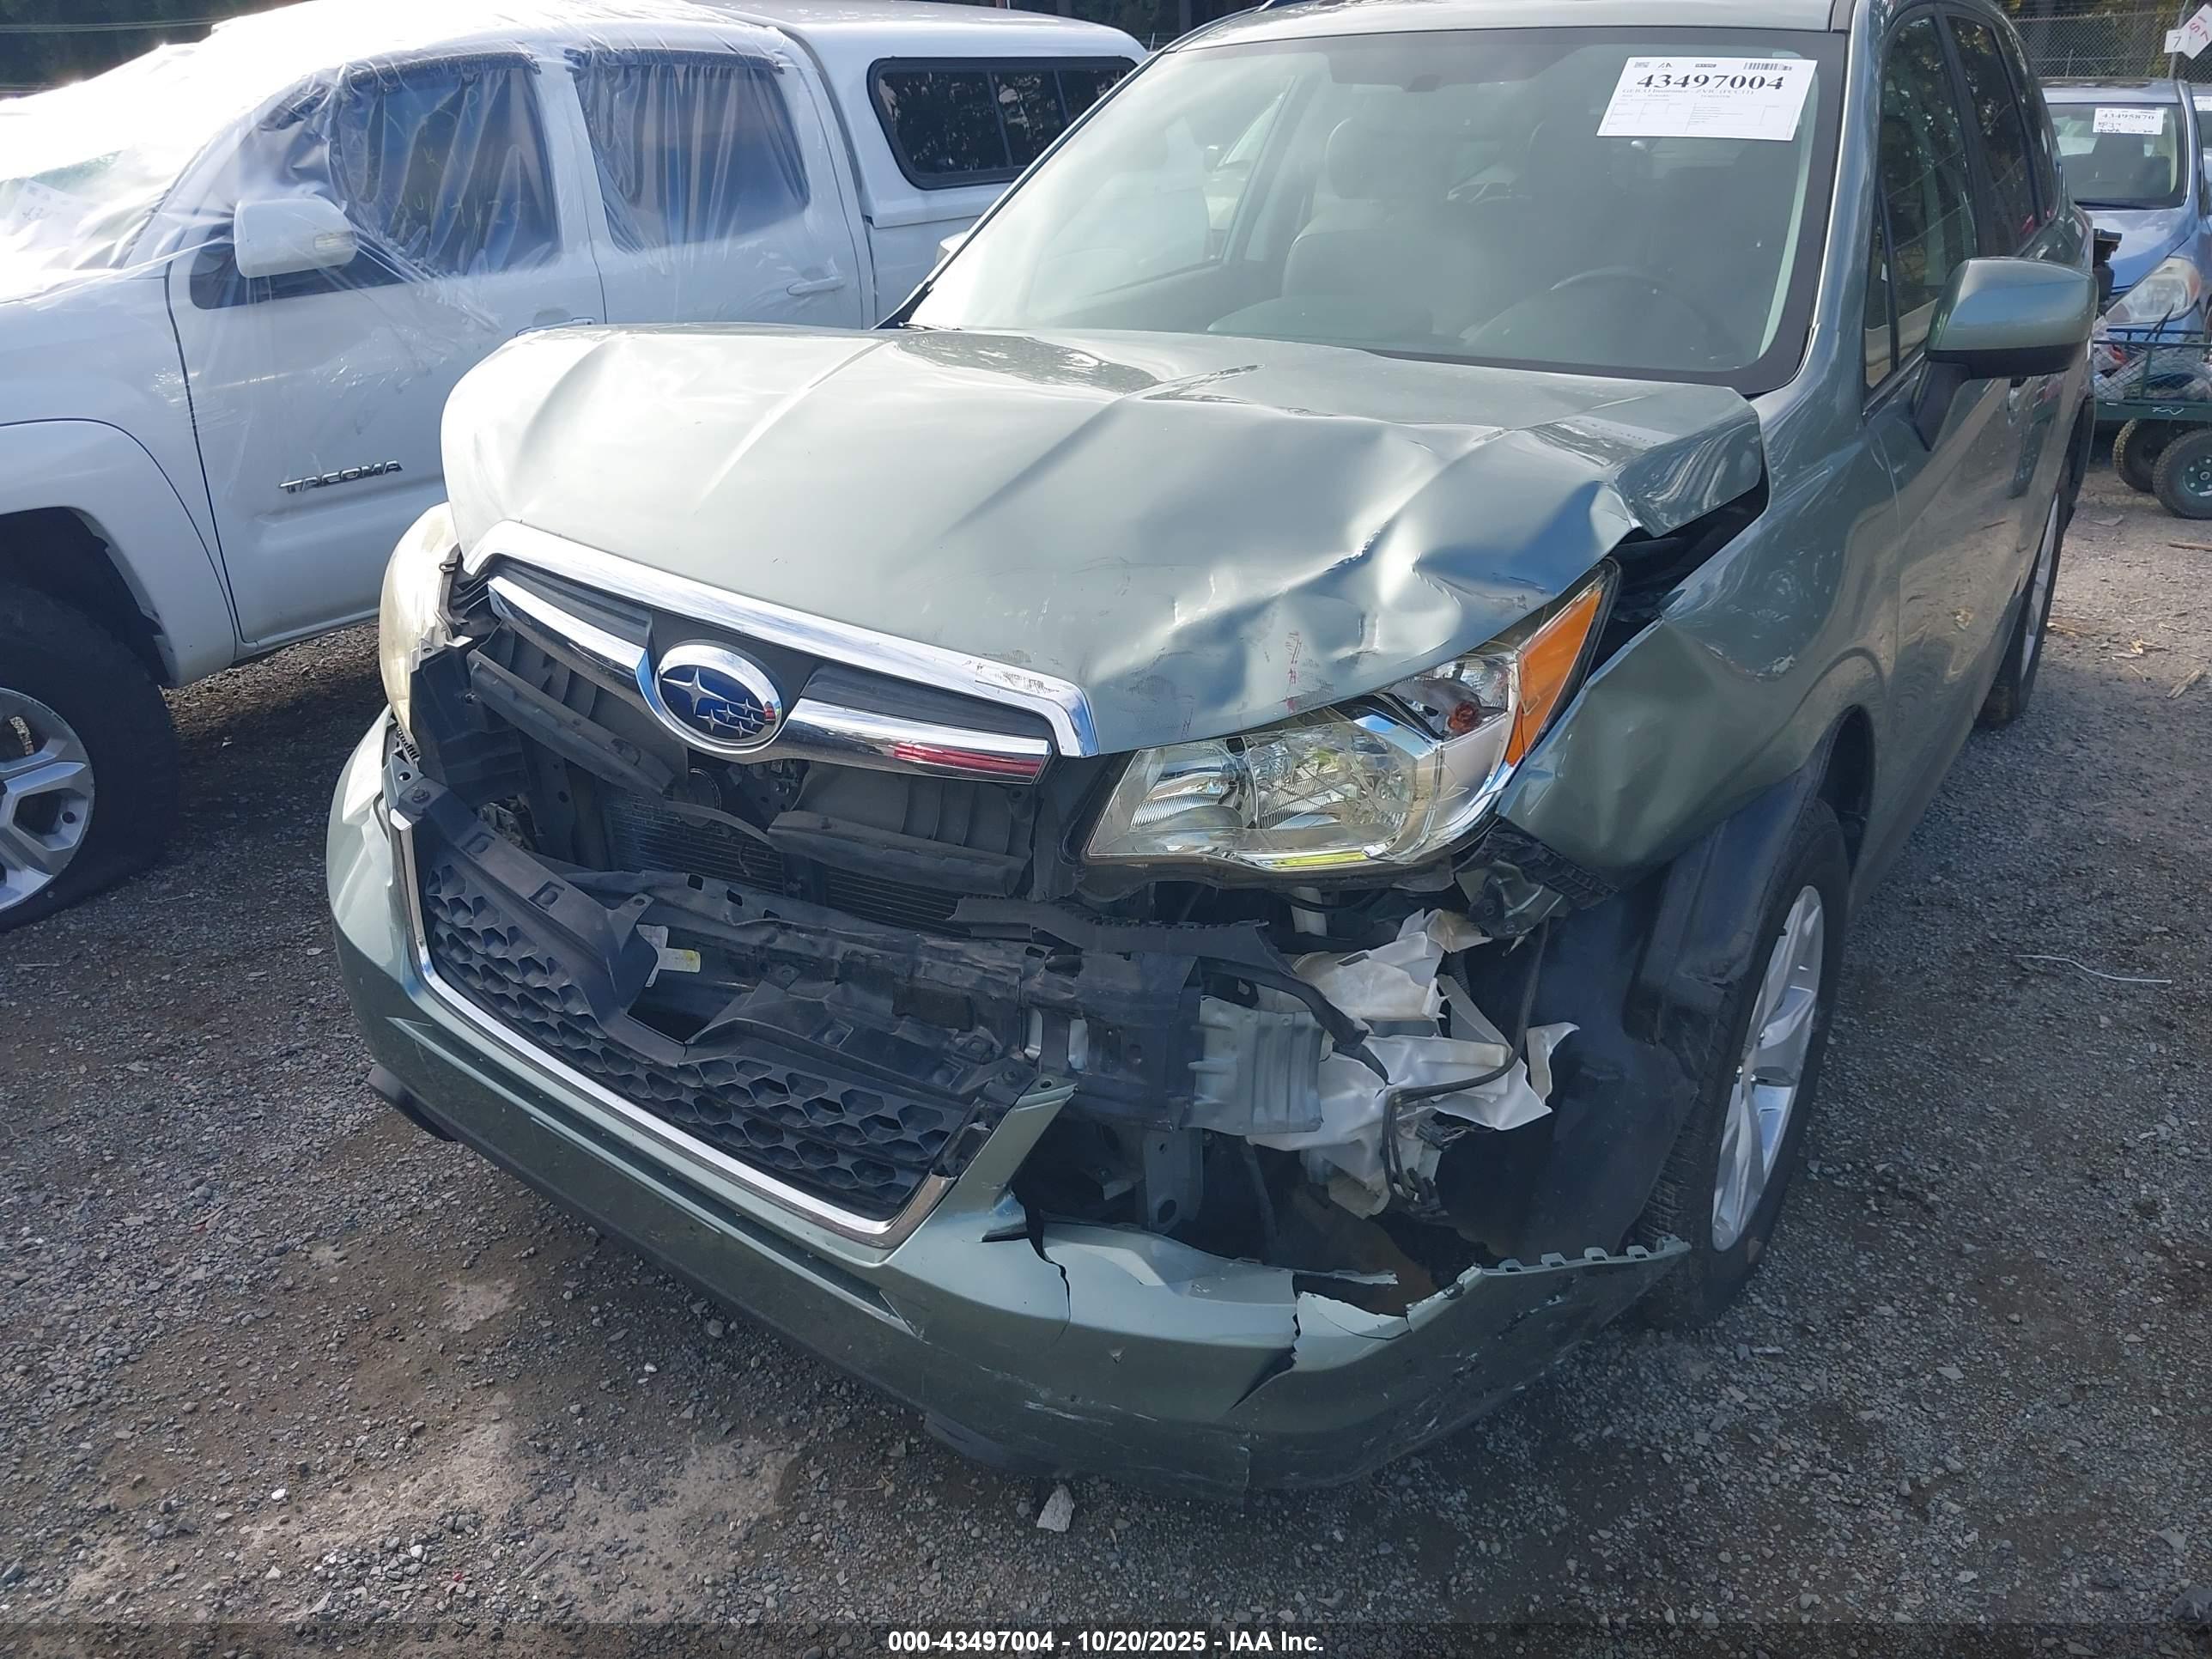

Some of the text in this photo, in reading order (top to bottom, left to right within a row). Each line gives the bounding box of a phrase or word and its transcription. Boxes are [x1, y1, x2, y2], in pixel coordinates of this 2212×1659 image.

[2172, 36, 2182, 49] 7
[1637, 74, 1784, 90] 43497004
[278, 459, 404, 495] TACOMA
